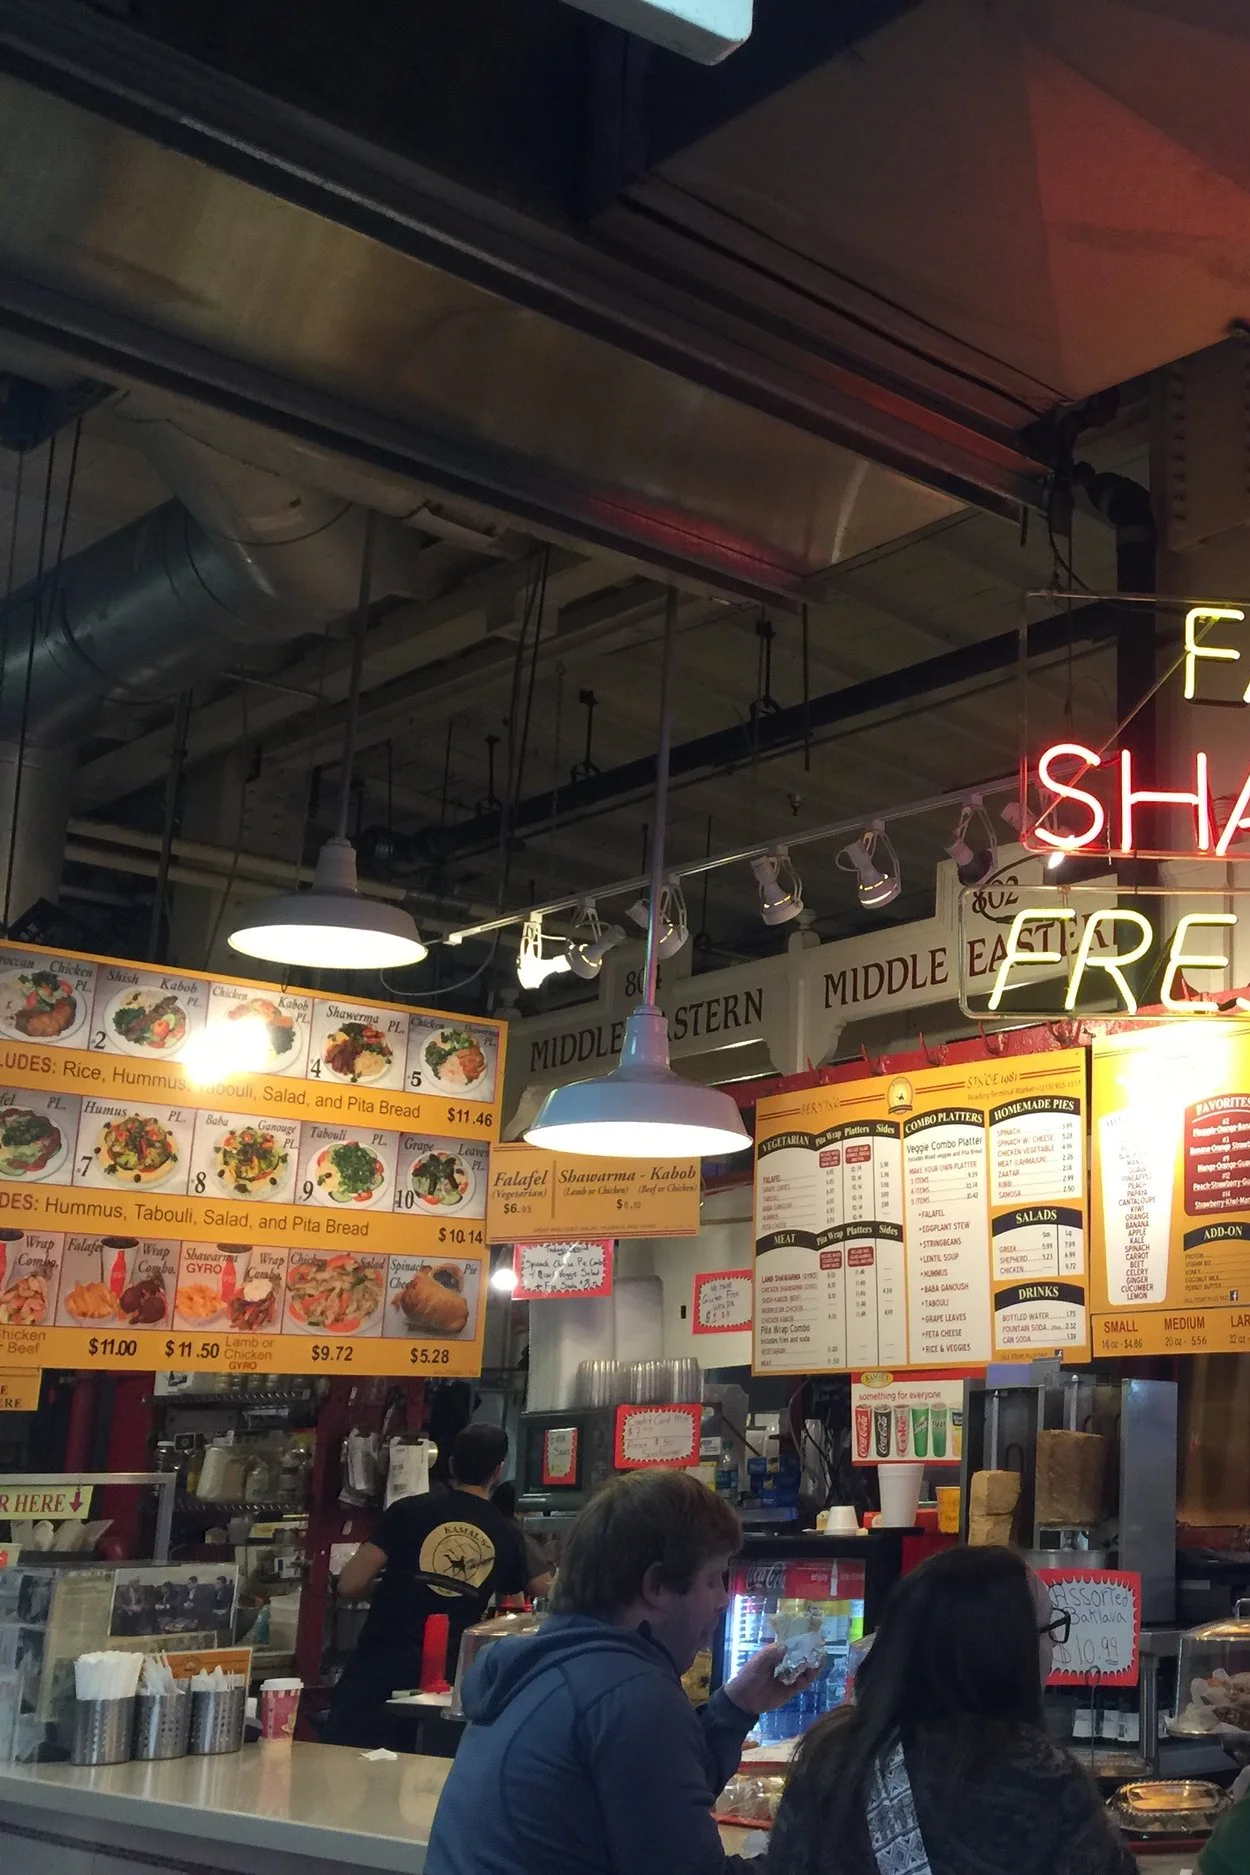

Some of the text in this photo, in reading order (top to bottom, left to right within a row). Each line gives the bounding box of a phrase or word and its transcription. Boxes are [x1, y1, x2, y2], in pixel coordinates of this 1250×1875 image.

[50, 959, 93, 978] Chicken
[106, 968, 199, 994] Shish Kabob
[824, 946, 949, 1010] MIDDLE
[212, 985, 310, 1012] Chicken Kabob
[325, 1004, 406, 1035] Shawerma PL.
[530, 1019, 625, 1073] MIDDLE
[63, 1060, 106, 1083] Rice,
[112, 1066, 191, 1091] Hummus,
[263, 1085, 310, 1107] Salad,
[315, 1094, 342, 1110] and
[347, 1096, 375, 1114] Pita
[379, 1099, 421, 1119] Bread
[447, 1106, 494, 1128] $11.46
[83, 1100, 187, 1124] Humus PL.
[994, 1098, 1076, 1121] HOMEMADE PIES
[205, 1113, 298, 1136] Baba Ganouge
[905, 1111, 983, 1135] COMBO PLATTERS
[310, 1125, 388, 1147] Tabouli PL.
[761, 1123, 895, 1152] VEGETARIAN Platters Sides
[404, 1137, 489, 1158] Grape Leaves
[906, 1136, 983, 1155] Veggie Combo Platter
[493, 1165, 697, 1191] Falafel Shawarma Kabob
[491, 1187, 548, 1201] (Vegetarian)
[44, 1196, 128, 1221] Hummus,
[135, 1203, 198, 1226] Tabouli,
[203, 1209, 252, 1229] Salad,
[258, 1214, 287, 1231] and
[292, 1216, 321, 1233] Pita
[326, 1219, 370, 1237] Bread
[1015, 1208, 1058, 1224] SALADS
[1125, 1212, 1150, 1221] ORANGE
[921, 1221, 971, 1233] EGGPLANT STEW
[1125, 1220, 1150, 1230] BANANA
[773, 1224, 899, 1245] MEAT Platters Sides
[1127, 1228, 1147, 1238] APPLE
[1129, 1236, 1145, 1244] KALE
[1203, 1225, 1243, 1241] ADD-ON
[25, 1234, 56, 1252] Wrap
[922, 1237, 962, 1249] STRINGBEANS
[1124, 1243, 1151, 1253] SPINACH
[142, 1242, 171, 1260] Wrap
[922, 1252, 960, 1264] LENTIL SOUP
[1125, 1251, 1150, 1261] CARROT
[186, 1262, 222, 1276] GYRO
[462, 1262, 479, 1277] Pie
[1129, 1260, 1145, 1269] BEET
[1125, 1268, 1149, 1278] CELERY
[1125, 1276, 1149, 1285] GINGER
[924, 1284, 940, 1294] BABA
[1018, 1285, 1060, 1300] DRINKS
[1120, 1284, 1154, 1293] CUCUMBER
[1126, 1292, 1148, 1301] LEMON
[925, 1312, 967, 1323] GRAPE LEAVES
[1164, 1316, 1206, 1331] MEDIUM
[925, 1328, 963, 1339] FETA CHEESE
[1103, 1319, 1139, 1334] SMALL
[88, 1337, 138, 1357] $11.00
[224, 1335, 259, 1349] Lamb
[925, 1343, 972, 1354] RICE VEGGIES
[223, 1348, 273, 1362] Chicken
[311, 1344, 354, 1362] $9.72
[409, 1347, 450, 1364] $5.28
[228, 1360, 258, 1371] GYRO
[858, 1390, 942, 1402] something for everyone
[13, 1493, 67, 1513] HERE
[1062, 1605, 1128, 1626] Baklava
